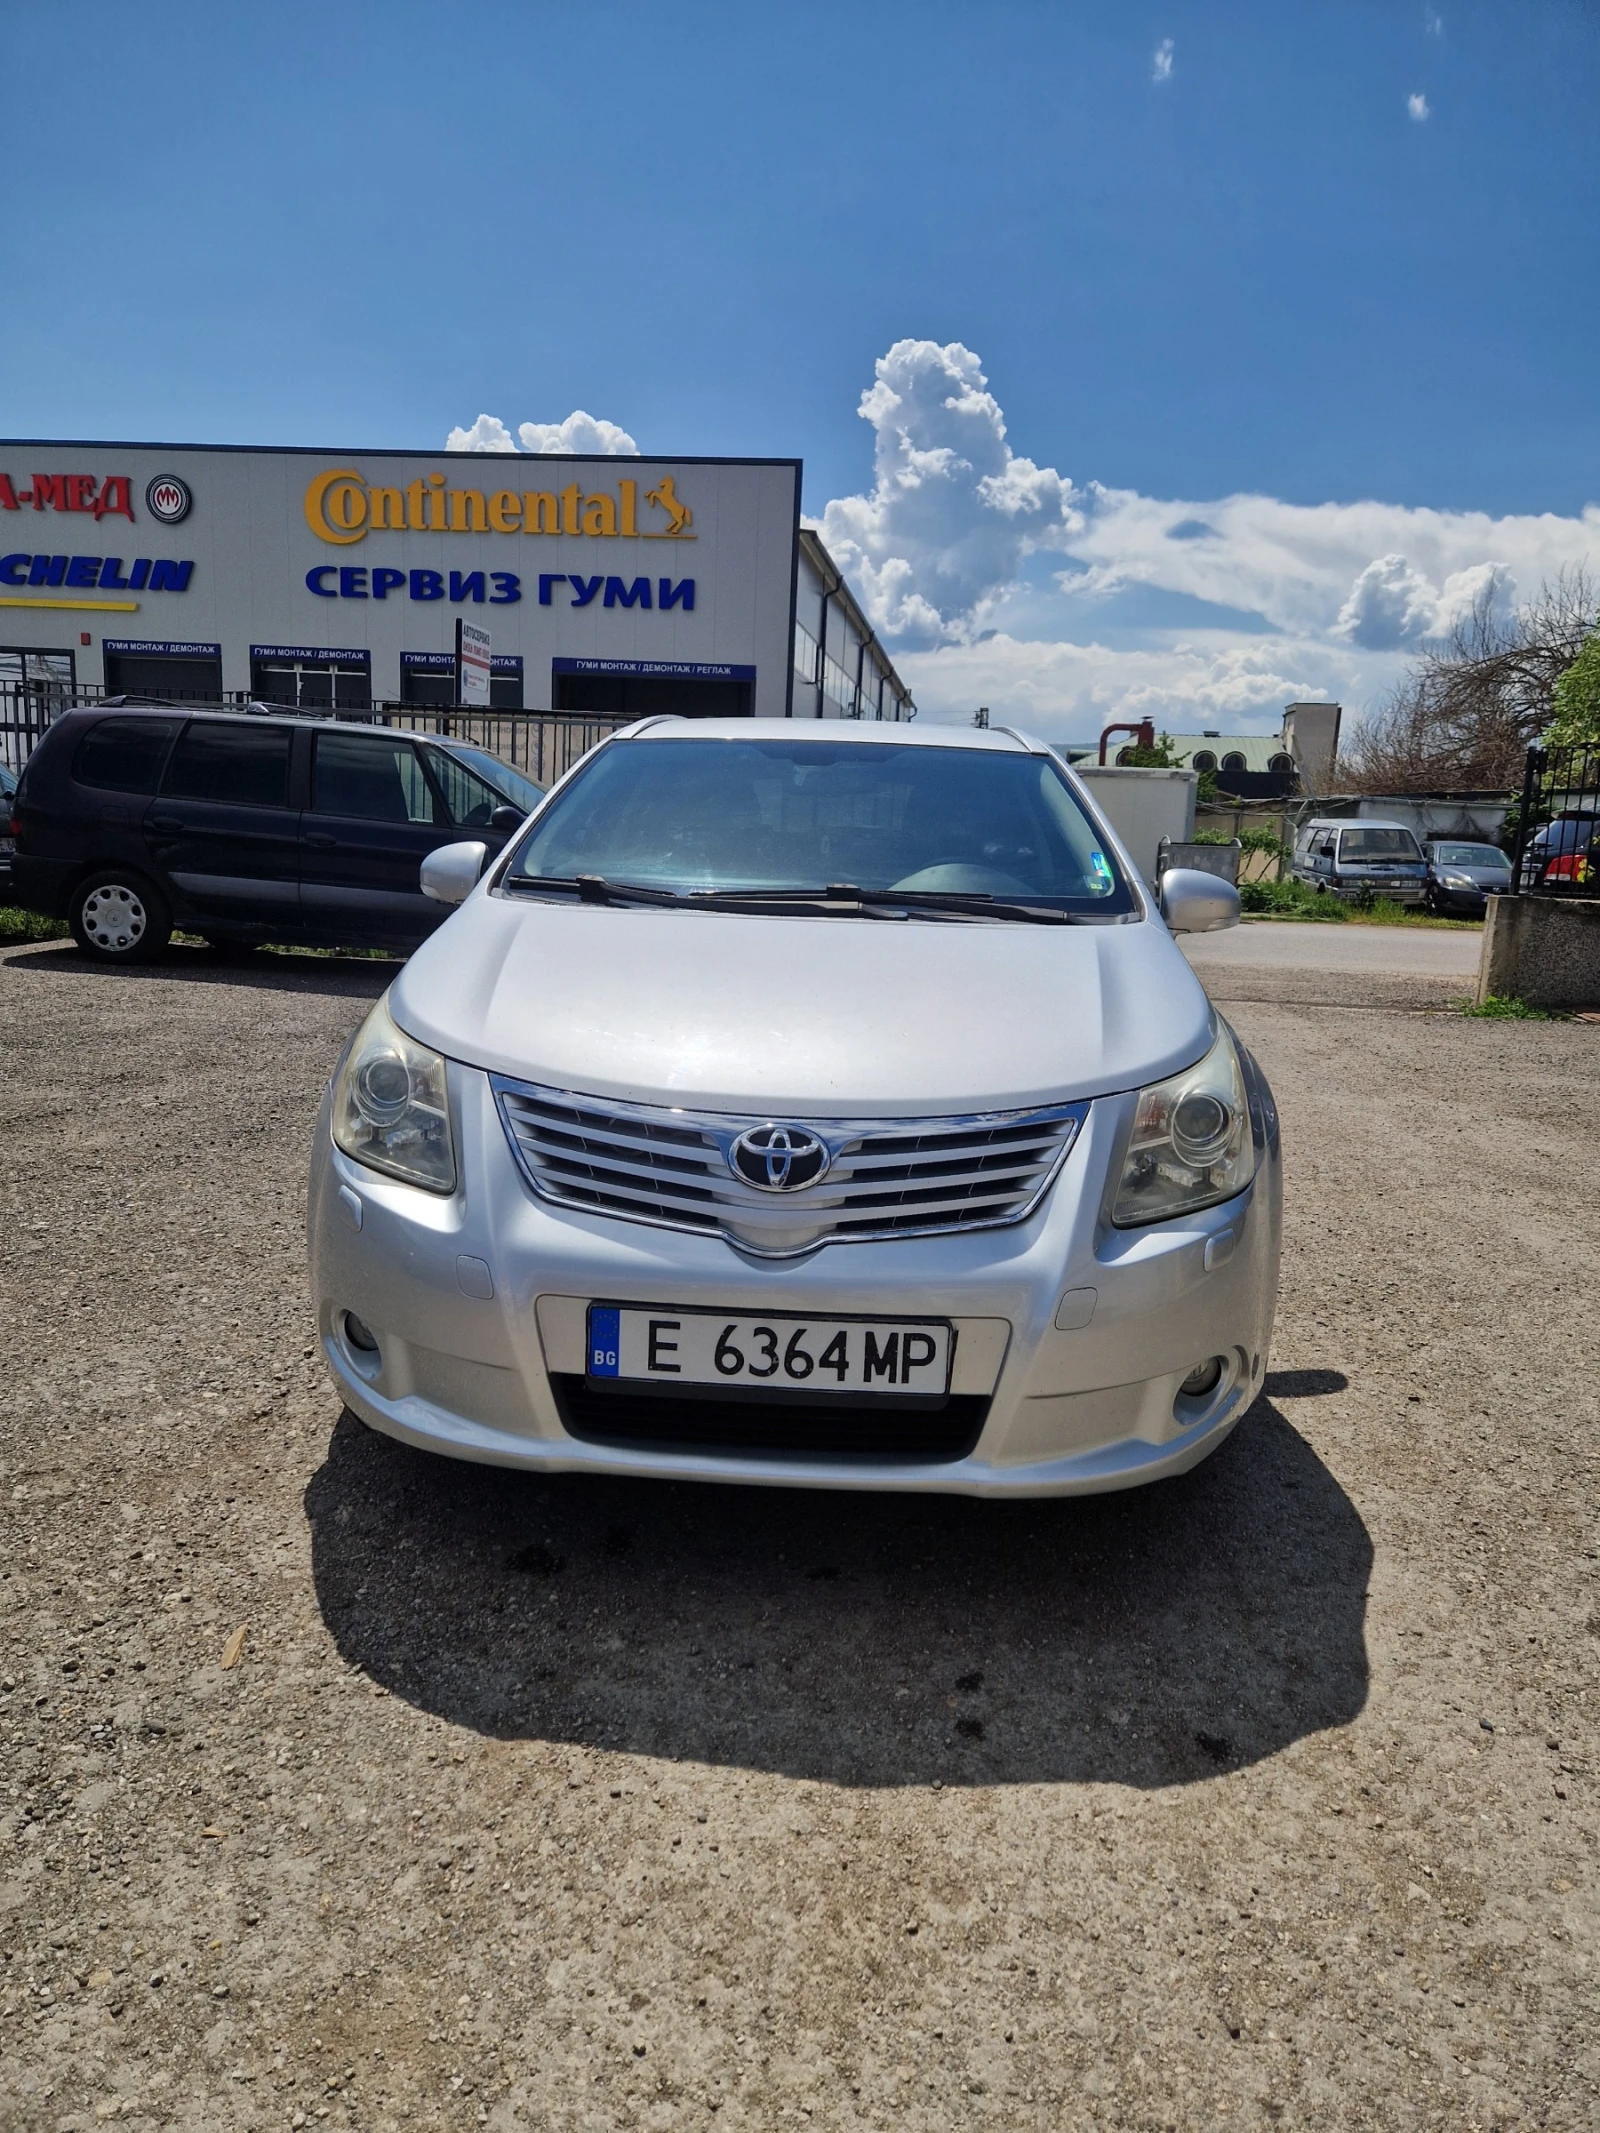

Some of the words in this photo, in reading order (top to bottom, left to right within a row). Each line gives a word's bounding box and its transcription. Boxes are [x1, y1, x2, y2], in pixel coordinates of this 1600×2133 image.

[305, 468, 638, 544] Continental
[306, 566, 522, 604] СЕРВИЗ
[538, 573, 695, 610] ГУМИ
[107, 642, 128, 650] ГУМИ
[130, 643, 164, 652] МОНТАЖ
[170, 644, 215, 653] ДЕМОНТАЖ
[254, 648, 276, 656] ГУМИ
[278, 649, 313, 658] МОНТАЖ
[318, 650, 364, 659] ДЕМОНТАЖ
[405, 655, 427, 663] ГУМИ
[429, 656, 456, 664] МОНТА
[490, 657, 517, 666] ОНТАЖ
[576, 661, 598, 669] ГУМИ
[600, 662, 637, 671] МОНТАЖ
[642, 663, 690, 673] ДЕМОНТАЖ
[697, 666, 731, 675] РЕГЛАЖ
[594, 1350, 616, 1366] BG
[648, 1320, 681, 1373] E
[714, 1325, 850, 1382] 6364
[863, 1331, 936, 1384] MP
